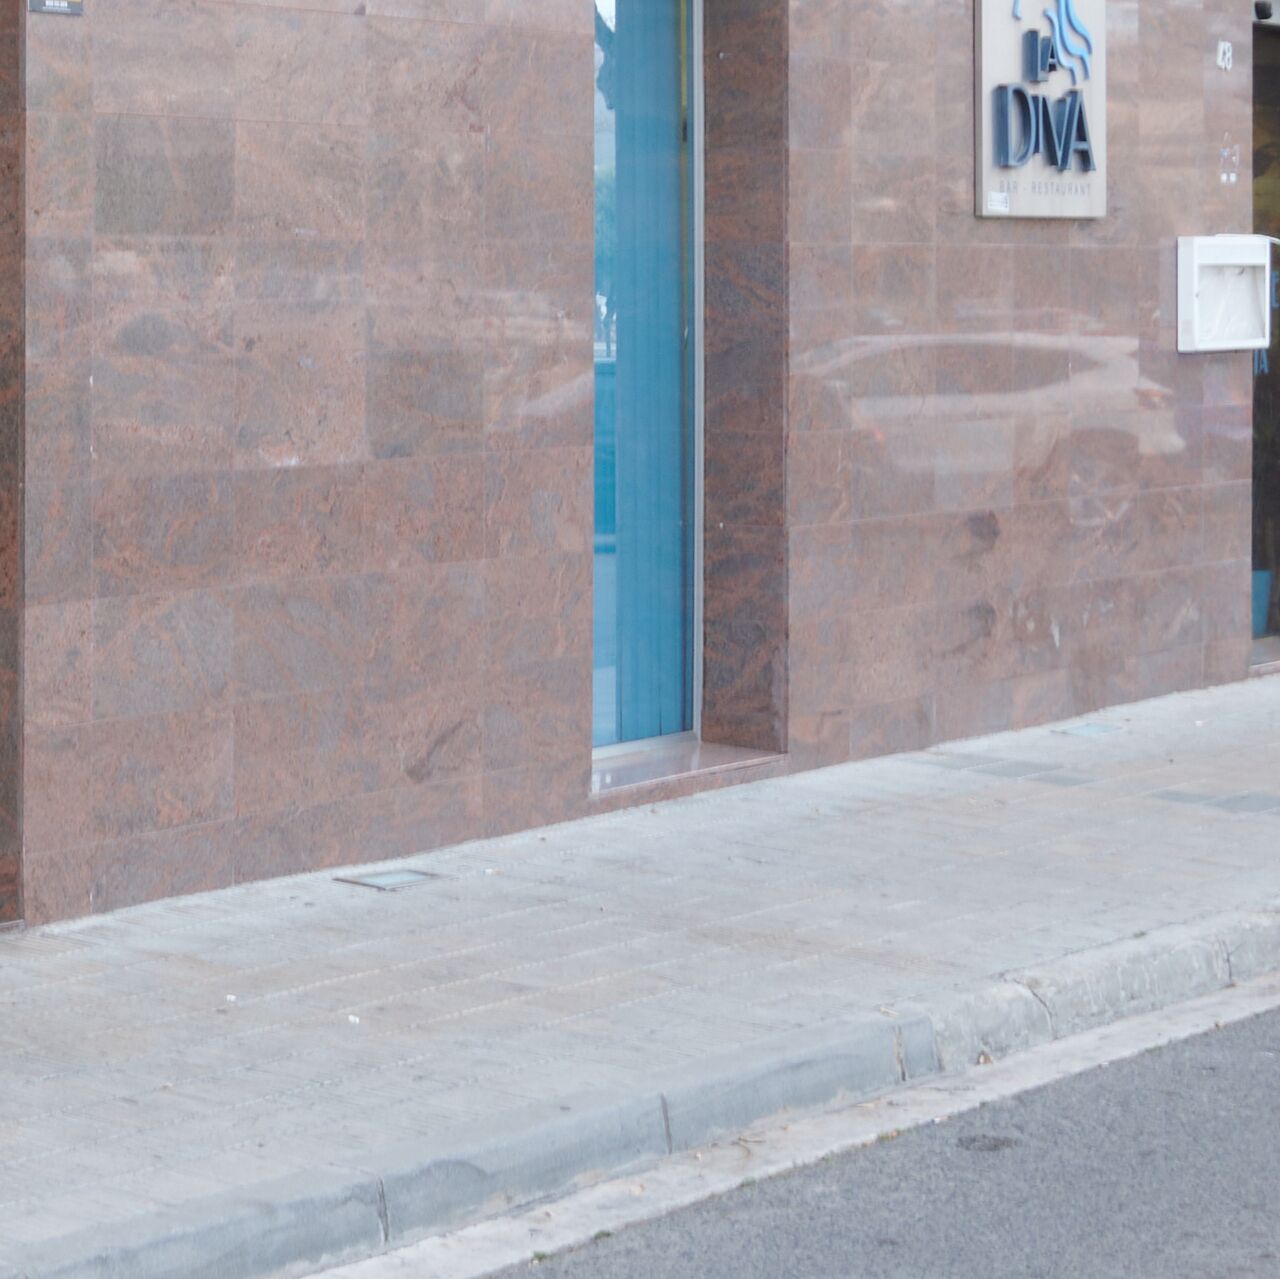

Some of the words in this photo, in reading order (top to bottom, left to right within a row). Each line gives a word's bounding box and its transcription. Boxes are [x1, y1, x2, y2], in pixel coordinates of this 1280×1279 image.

[1021, 28, 1058, 83] LA
[1216, 39, 1233, 72] 48
[991, 83, 1096, 173] DIVA
[999, 179, 1018, 193] BAR
[1031, 180, 1091, 197] RESTAURANT
